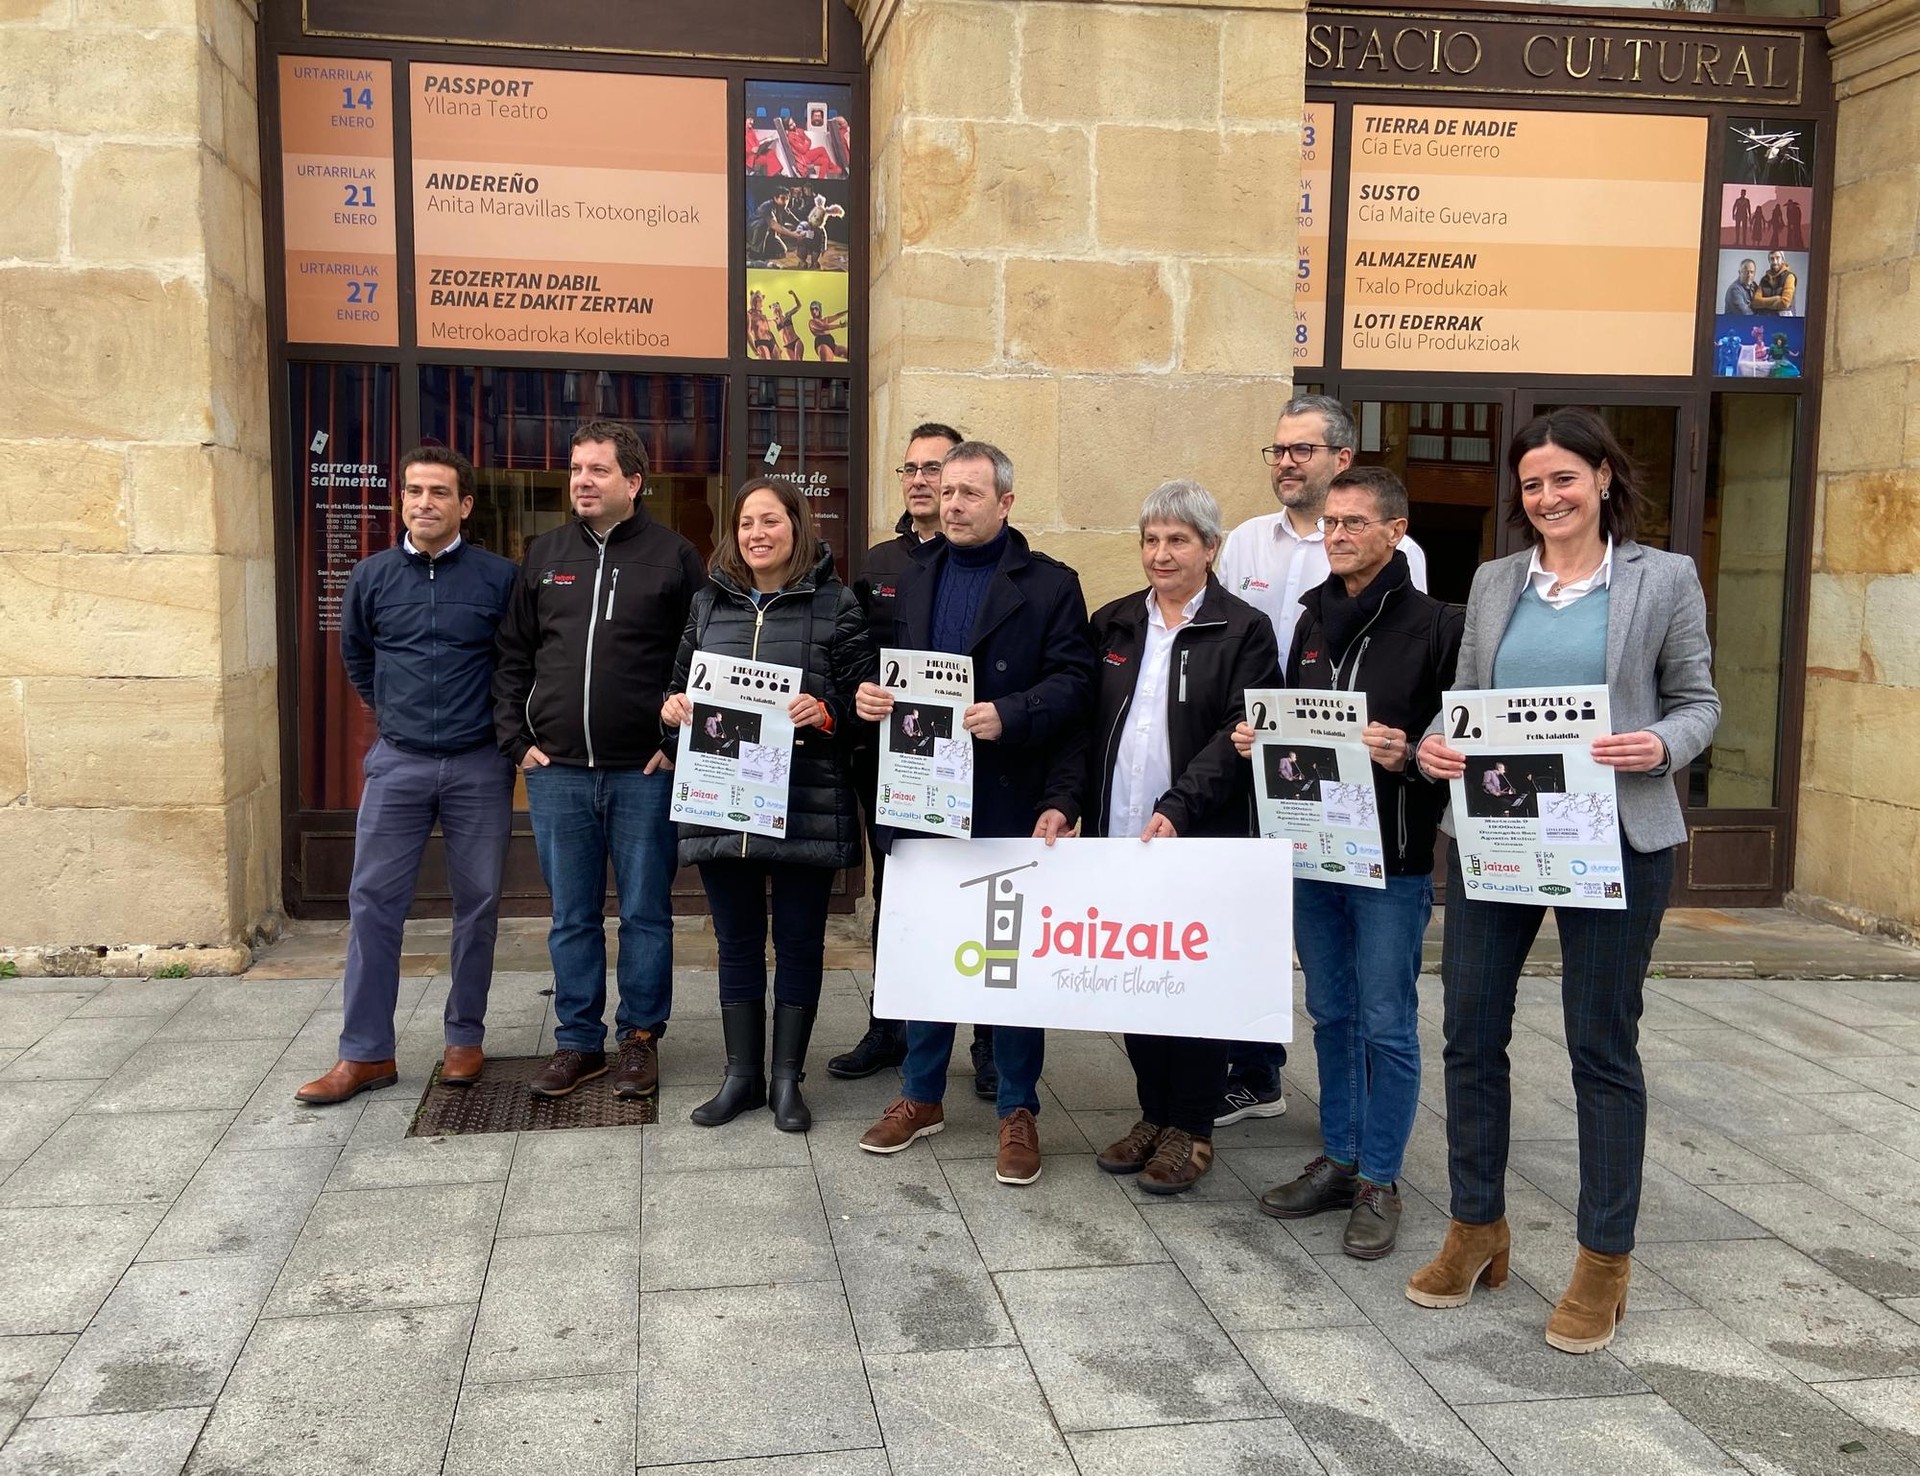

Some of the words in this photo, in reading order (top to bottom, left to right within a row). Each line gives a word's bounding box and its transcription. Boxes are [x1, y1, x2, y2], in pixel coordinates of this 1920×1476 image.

[1306, 23, 1483, 75] SPACIO
[1522, 33, 1790, 90] CULTURAL
[294, 66, 373, 83] URTARRILAK
[341, 86, 374, 110] 14
[424, 75, 534, 99] PASSPORT
[424, 95, 482, 120] Yllana
[487, 99, 549, 122] Teatro
[331, 113, 375, 130] ENERO
[1365, 116, 1431, 136] TIERRA
[1434, 118, 1460, 137] DE
[1461, 120, 1518, 139] NADIE
[1361, 136, 1390, 158] Cía
[1393, 138, 1423, 158] Eva
[1426, 139, 1500, 159] Guerrero
[297, 164, 377, 180] URTARRILAK
[425, 171, 540, 196] ANDEREÑO
[1360, 184, 1420, 202] SUSTO
[343, 184, 376, 209] 21
[333, 211, 378, 227] ENERO
[426, 194, 475, 216] Anita
[479, 195, 571, 221] Maravillas
[575, 200, 701, 228] Txotxongiloak
[1359, 204, 1387, 224] Cía
[1390, 205, 1436, 225] Maite
[1438, 207, 1508, 226] Guevara
[300, 261, 380, 278] URTARRILAK
[1355, 251, 1476, 270] ALMAZENEAN
[429, 268, 543, 290] ZEOZERTAN
[546, 272, 602, 293] DABIL
[1356, 277, 1401, 297] Txalo
[1405, 278, 1508, 299] Produkzioak
[346, 281, 379, 305] 27
[429, 288, 490, 310] BAINA
[492, 291, 517, 311] EZ
[519, 291, 579, 313] DAKIT
[580, 294, 654, 316] ZERTAN
[336, 308, 380, 323] ENERO
[1353, 313, 1395, 330] LOTI
[1399, 314, 1483, 333] EDERRAK
[431, 320, 570, 346] Metrokoadroka
[575, 324, 671, 348] Kolektiboa
[1353, 332, 1379, 351] Glu
[1385, 333, 1413, 351] Glu
[1417, 334, 1520, 353] Produkzioak
[311, 463, 378, 474] sarreren
[810, 471, 828, 484] de
[311, 474, 387, 488] salmenta
[691, 662, 712, 691] 2.
[884, 660, 908, 689] 2.
[1507, 696, 1577, 708] HIRUZULO
[1252, 701, 1277, 731] 2.
[1450, 705, 1482, 739] 2.
[1293, 861, 1318, 869] albi
[1483, 861, 1521, 872] jaizale
[1482, 882, 1533, 893] Gualbi
[1032, 905, 1209, 961] jaizale
[1051, 964, 1118, 995] Txistulari
[1122, 967, 1186, 997] Elkartea
